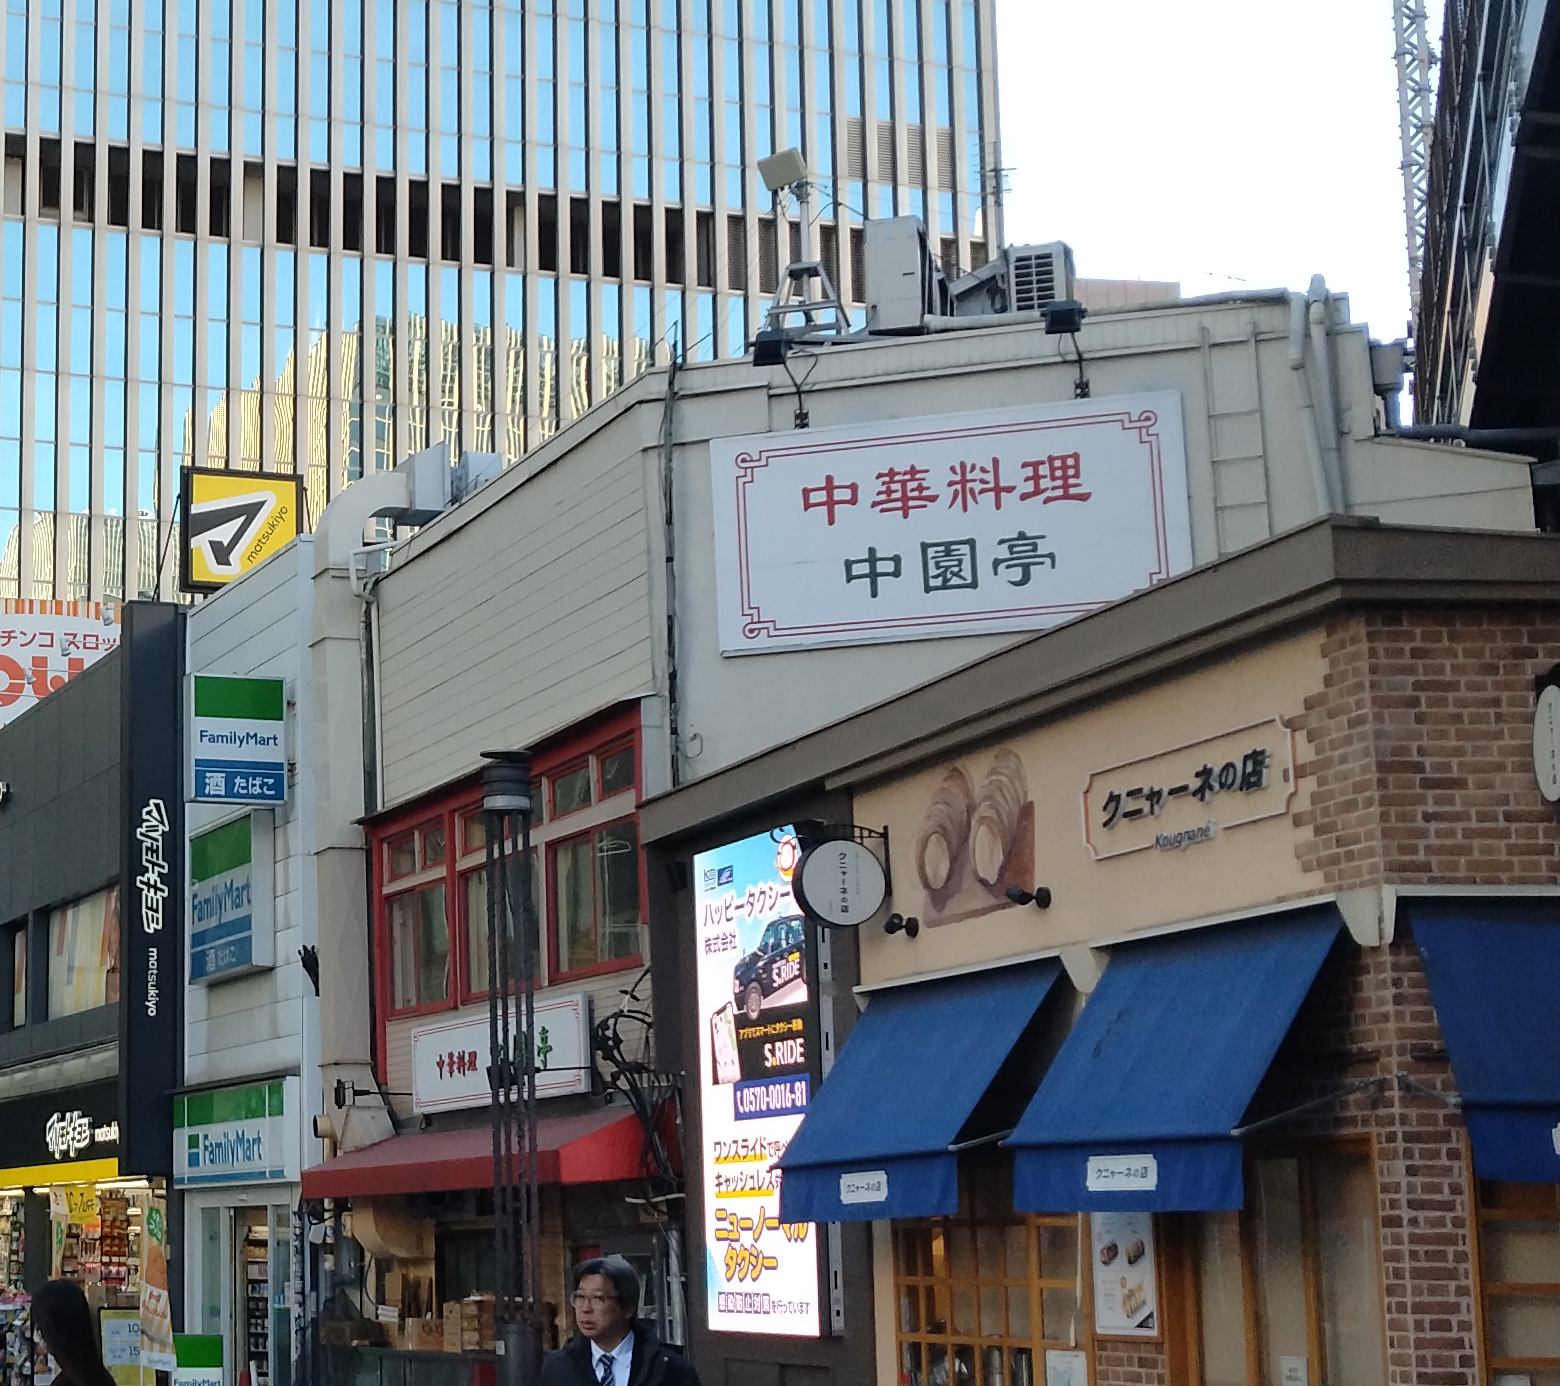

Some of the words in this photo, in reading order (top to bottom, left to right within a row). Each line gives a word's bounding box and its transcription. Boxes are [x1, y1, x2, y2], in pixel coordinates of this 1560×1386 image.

[802, 452, 1093, 526] 中華料理
[246, 506, 289, 564] matsukiyo
[844, 531, 1057, 599] 中園亭
[62, 631, 122, 652] スロッ
[199, 729, 278, 748] FamilyMart
[204, 772, 226, 796] 酒
[233, 775, 276, 795] たばこ
[1102, 748, 1269, 828] クニャーネの店
[192, 876, 251, 925] FamilyMart
[704, 886, 791, 927] ハッピータクシー
[145, 947, 160, 1017] matsukiyo
[764, 1037, 806, 1068] S.RIDE
[203, 1128, 263, 1168] FamilyMart
[724, 1243, 778, 1283] タクシー
